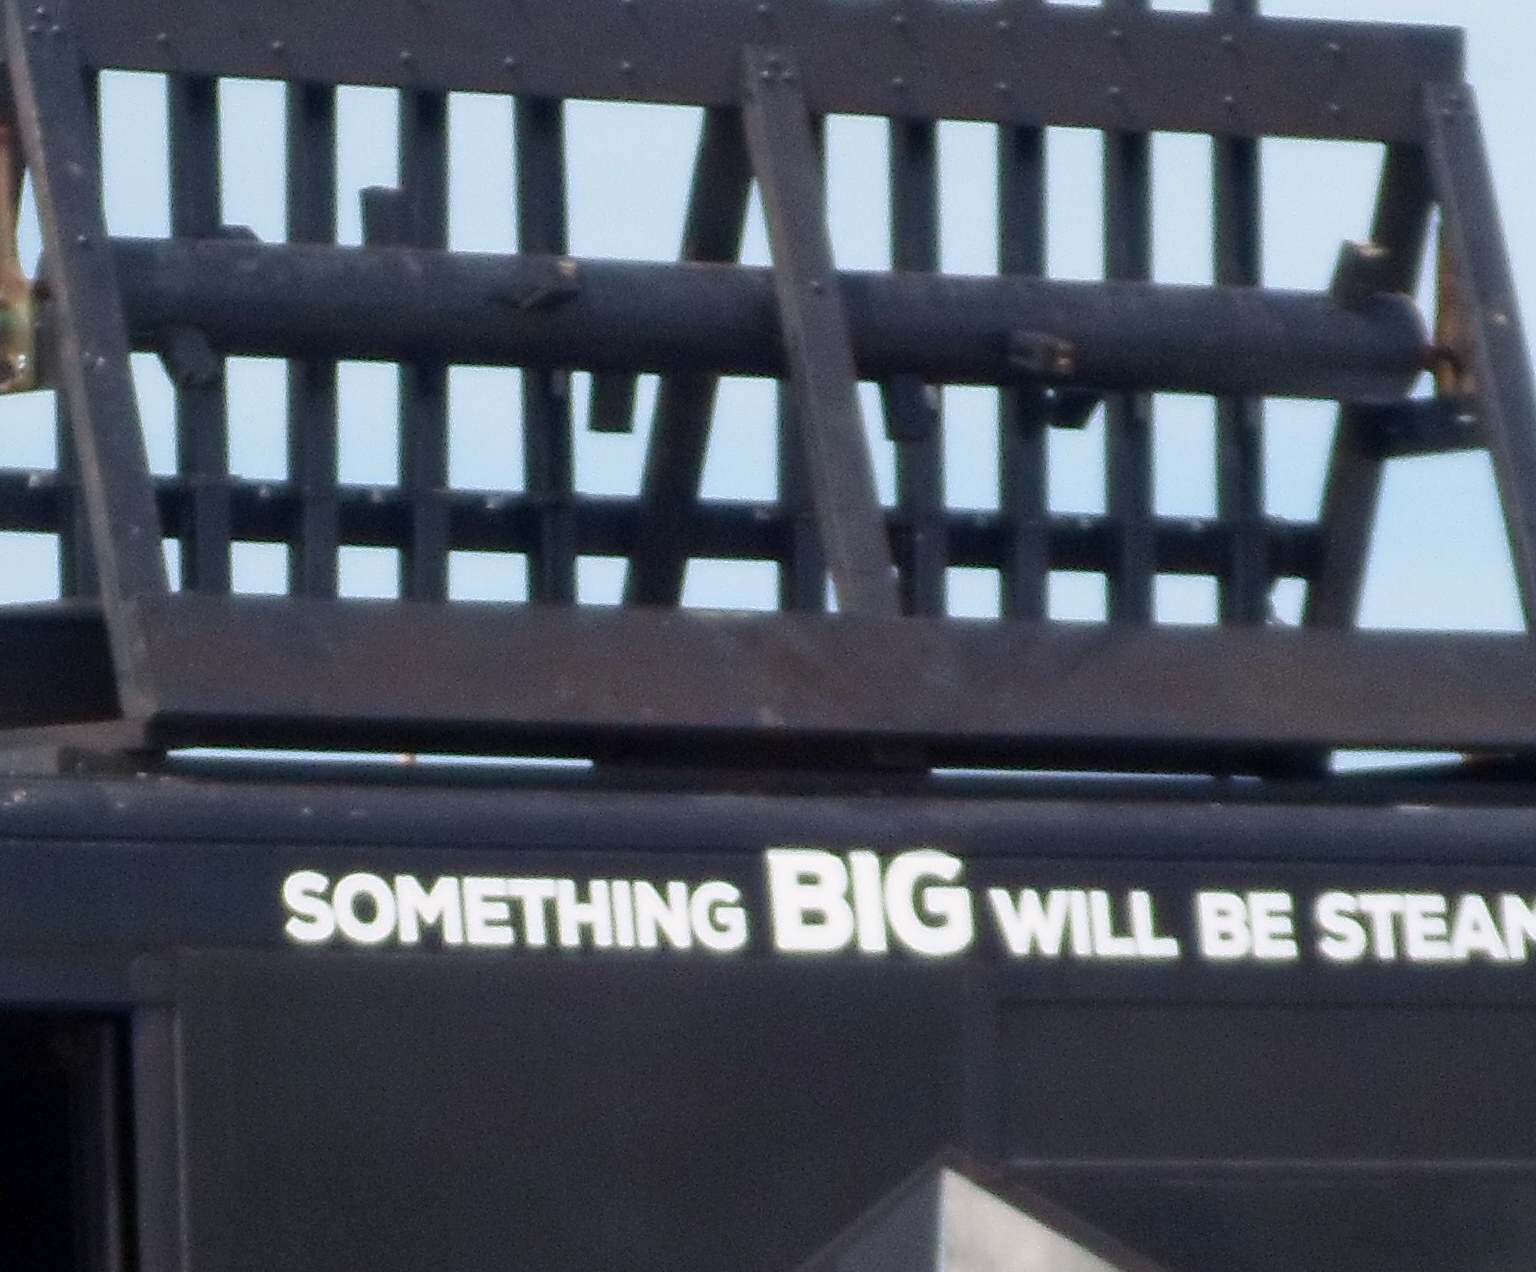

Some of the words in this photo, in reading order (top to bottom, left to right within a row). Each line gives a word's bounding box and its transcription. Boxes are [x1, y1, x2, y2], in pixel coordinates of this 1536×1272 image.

[280, 868, 748, 952] SOMETHING
[766, 847, 974, 955] BIG
[989, 887, 1180, 958] WILL
[1197, 888, 1298, 960] BE
